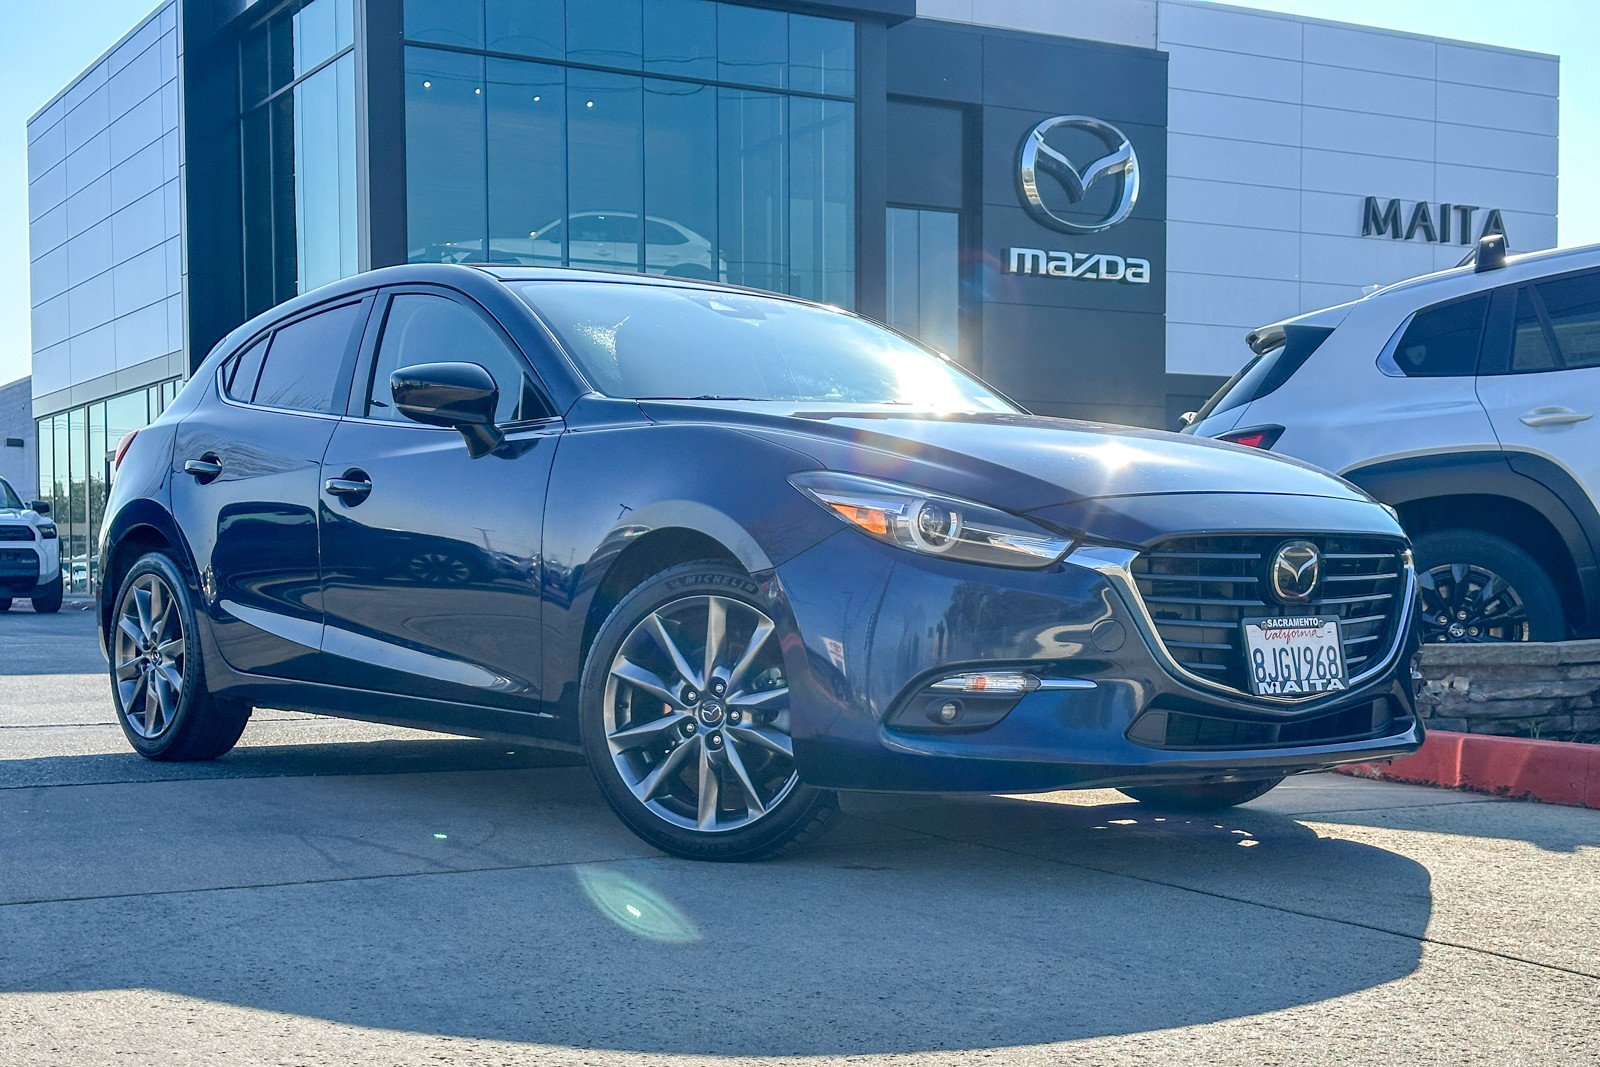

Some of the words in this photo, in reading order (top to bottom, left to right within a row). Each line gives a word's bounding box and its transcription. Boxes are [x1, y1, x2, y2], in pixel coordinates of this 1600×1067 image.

[1361, 195, 1510, 248] MAITA
[685, 574, 755, 593] MICHELIN
[1266, 617, 1319, 628] SACRAMENTO
[1264, 628, 1324, 645] California
[1252, 645, 1340, 683] 8JGV968
[1258, 678, 1346, 695] MAITA
